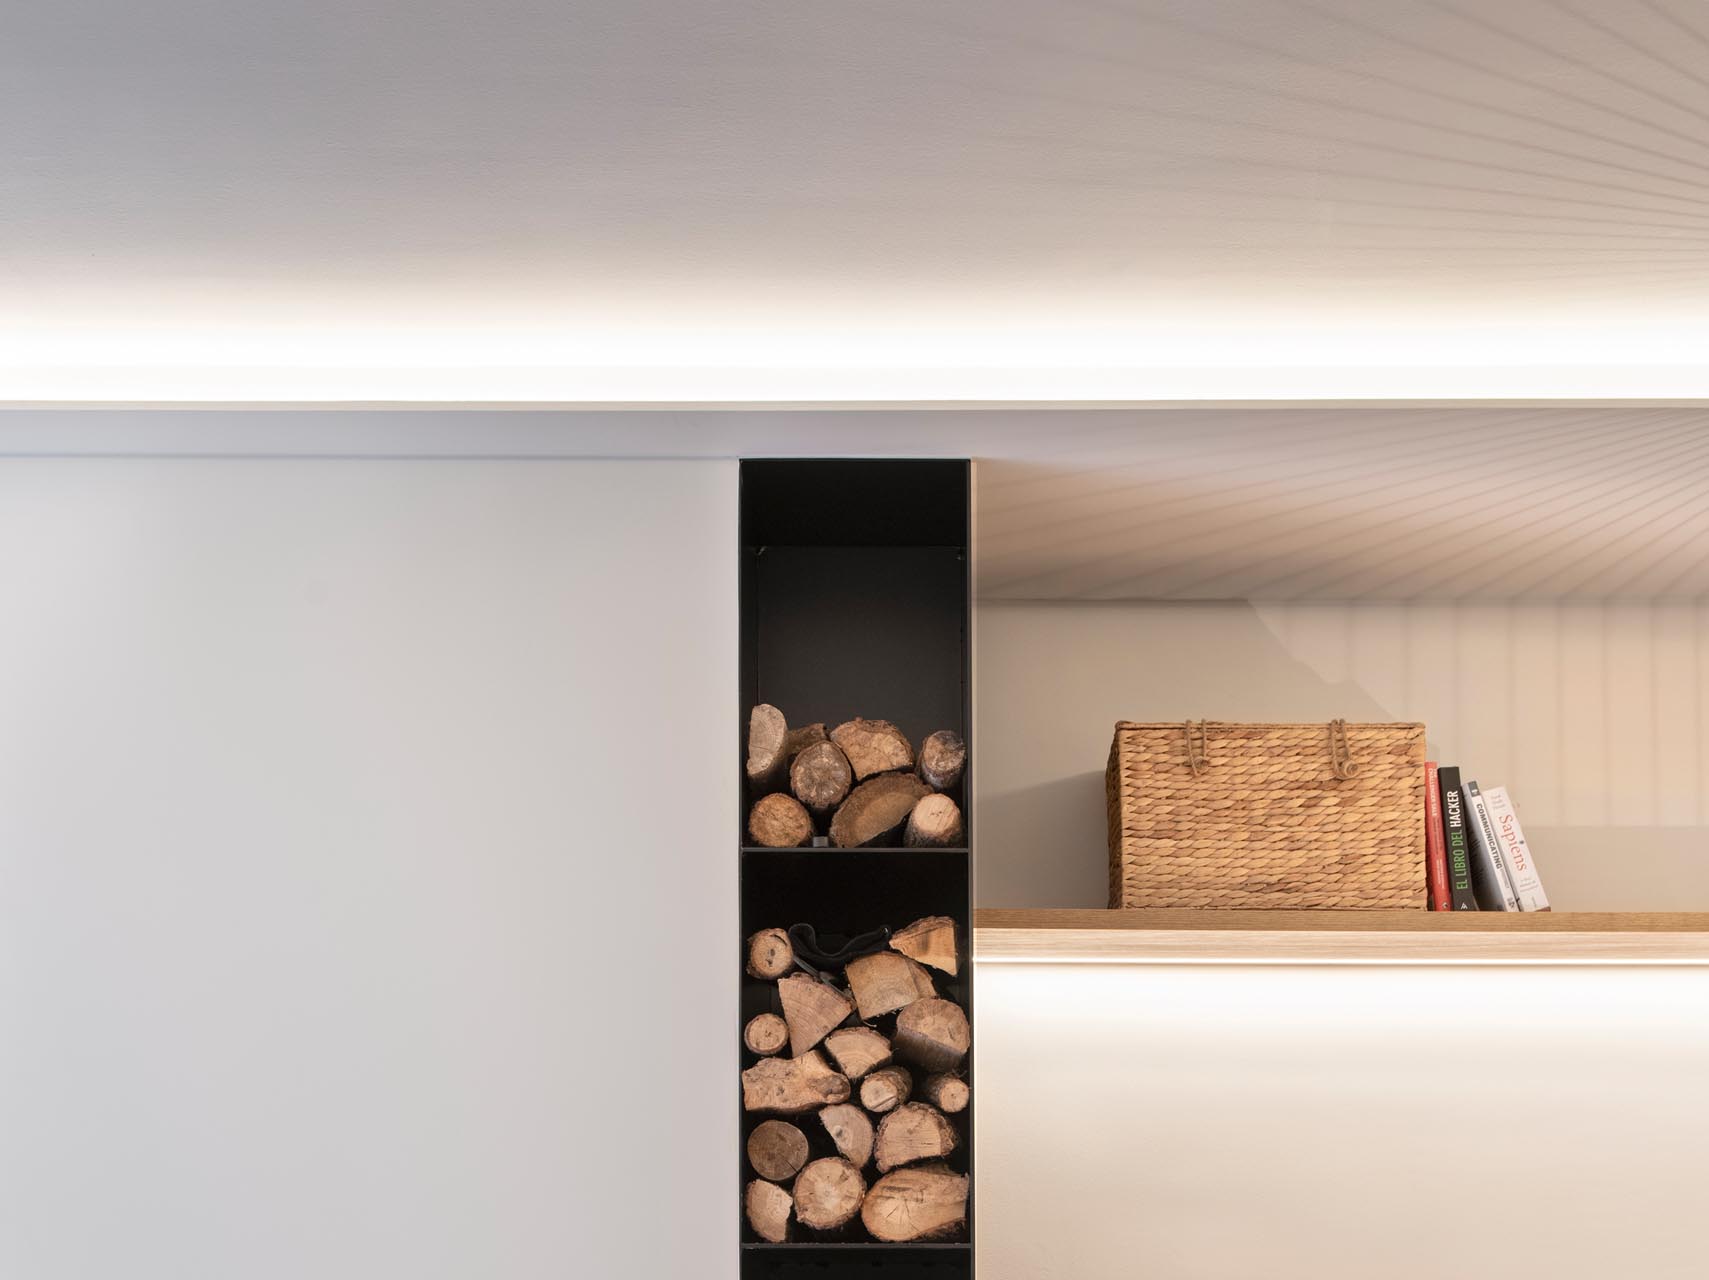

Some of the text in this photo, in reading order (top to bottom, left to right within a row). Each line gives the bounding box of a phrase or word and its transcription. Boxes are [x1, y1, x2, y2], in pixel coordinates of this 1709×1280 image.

[1447, 790, 1468, 890] EL LIBRO DEL HACKER
[1476, 803, 1503, 870] COMMUNICATING
[1499, 814, 1527, 871] Sapiens
